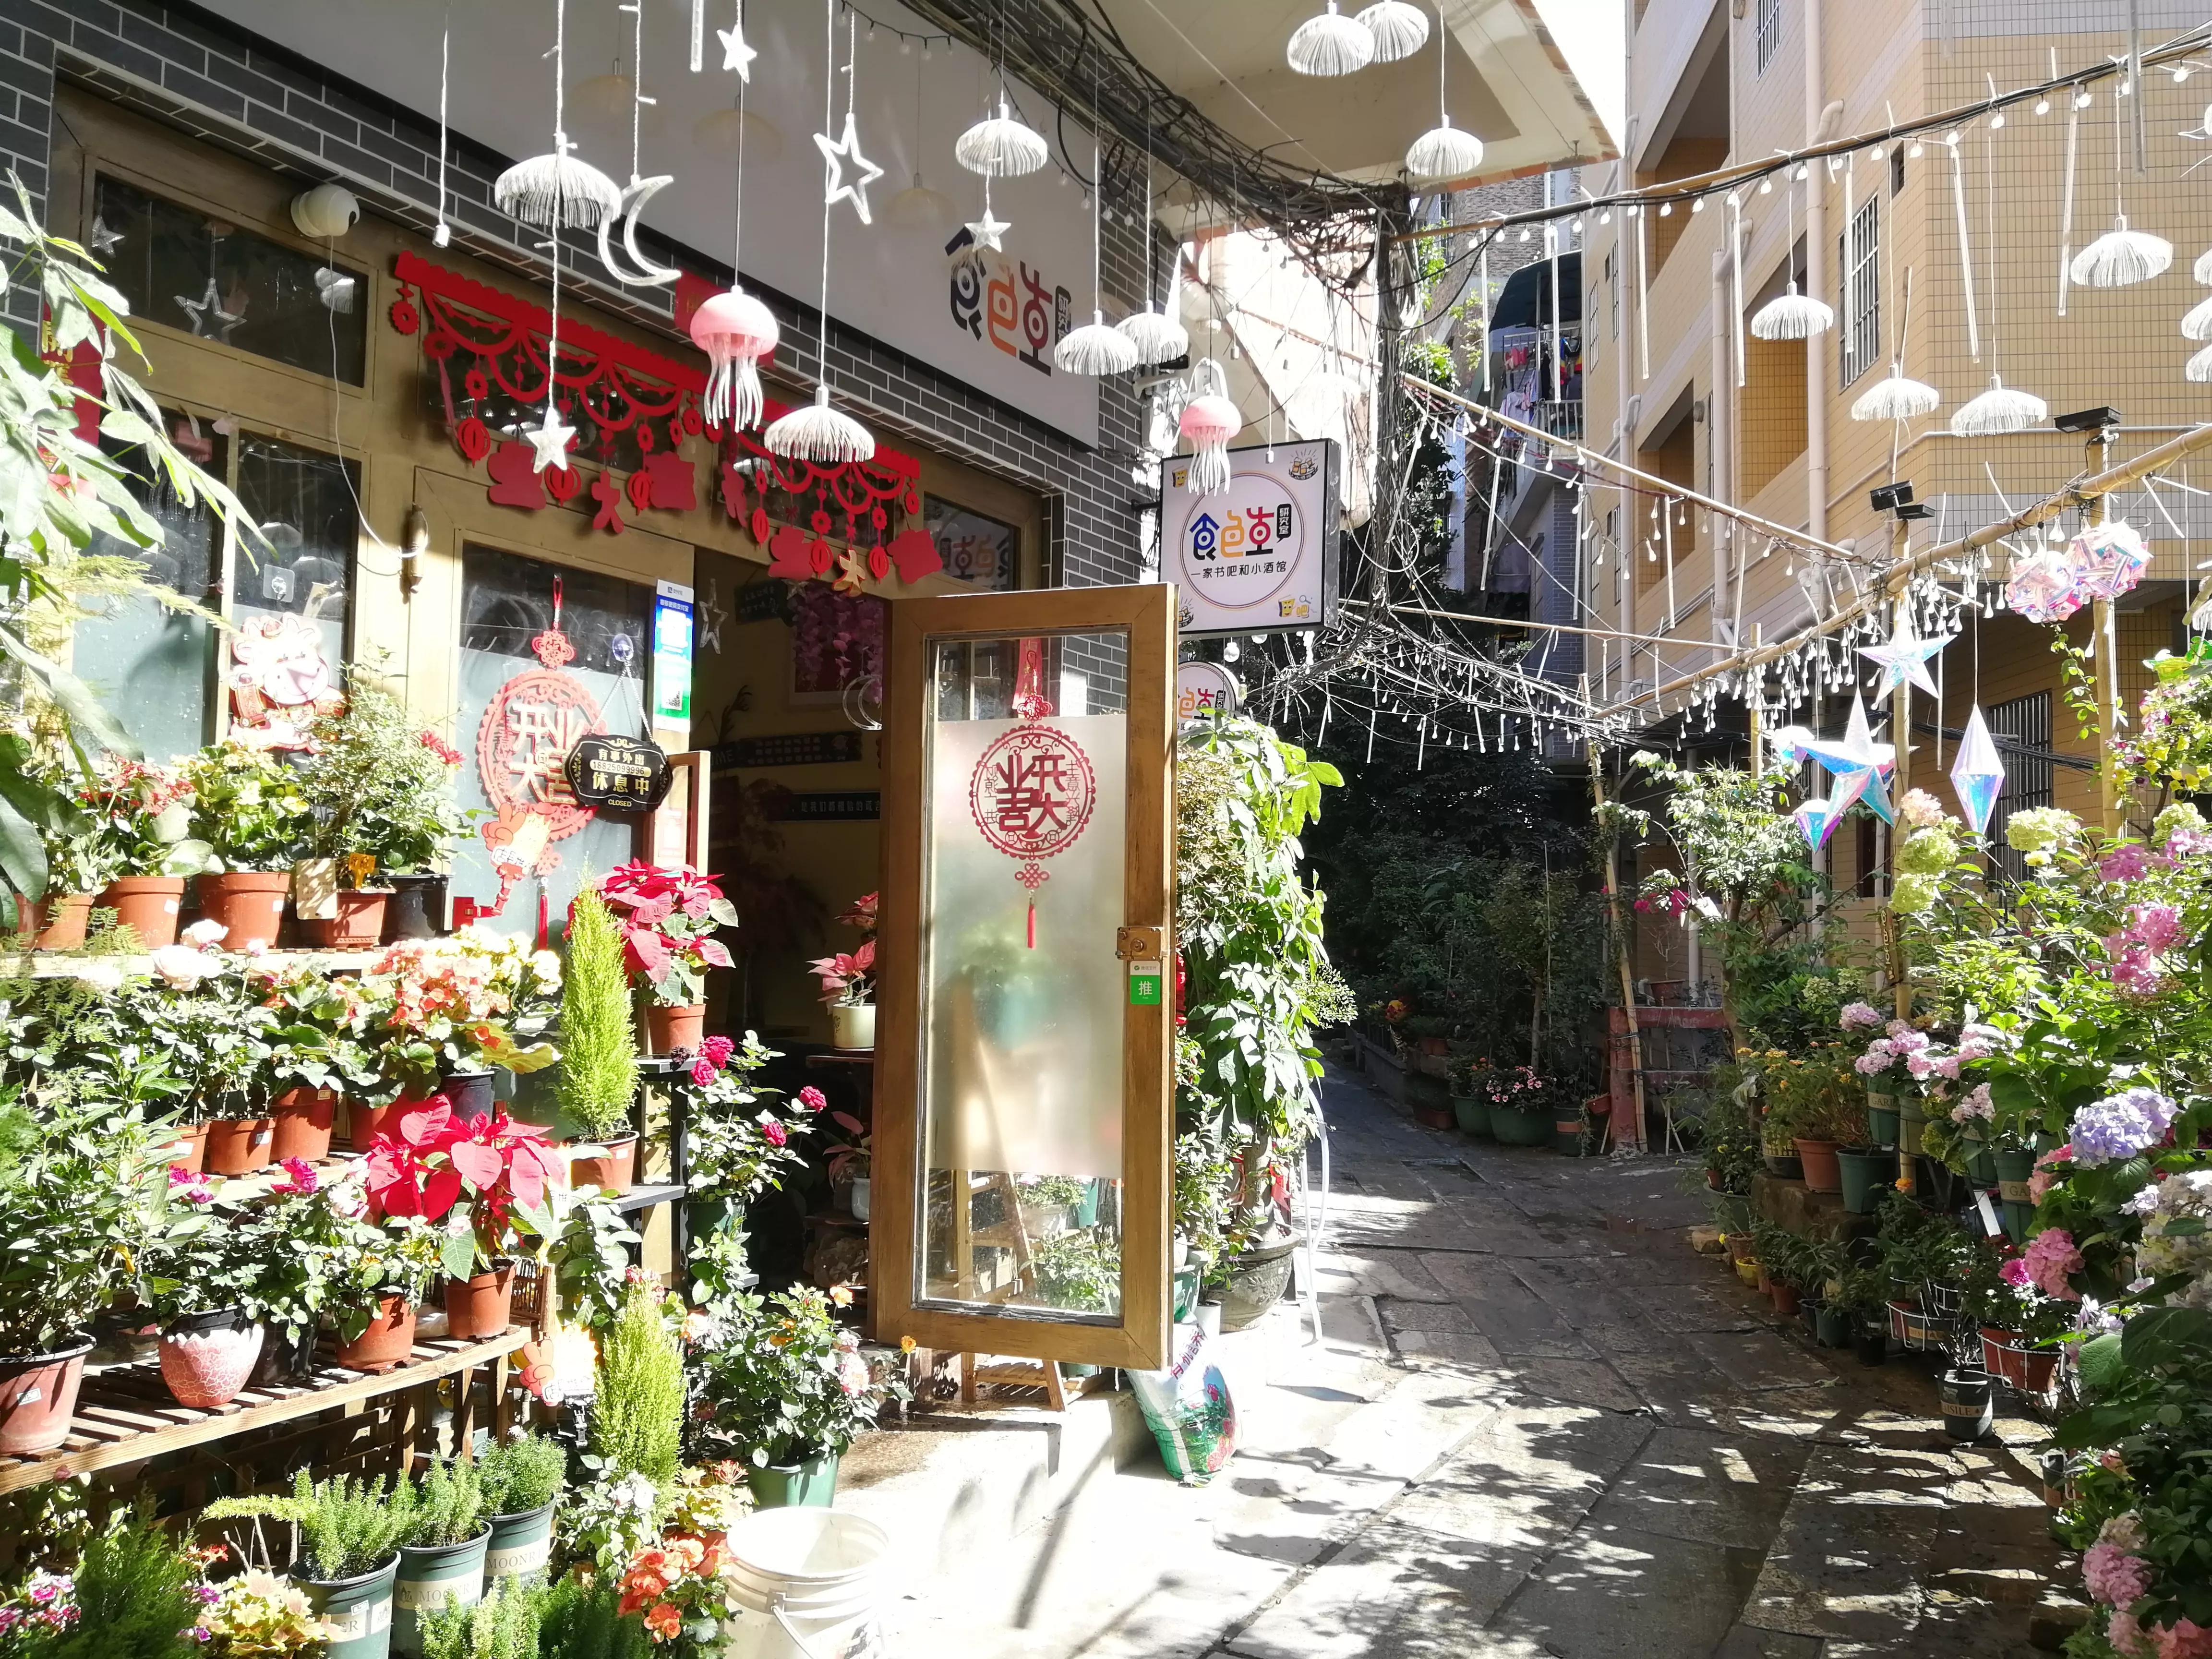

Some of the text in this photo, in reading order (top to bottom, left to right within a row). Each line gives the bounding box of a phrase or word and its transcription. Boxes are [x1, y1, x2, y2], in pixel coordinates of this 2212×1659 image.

[1279, 507, 1289, 535] 研究室
[1190, 561, 1287, 579] 一家书吧和小酒馆
[1297, 604, 1310, 619] 吧
[598, 748, 645, 766] 有事外出
[593, 761, 645, 775] 18825099996
[592, 771, 650, 795] 休息中
[608, 798, 633, 807] CLOSED
[1138, 980, 1153, 996] 推
